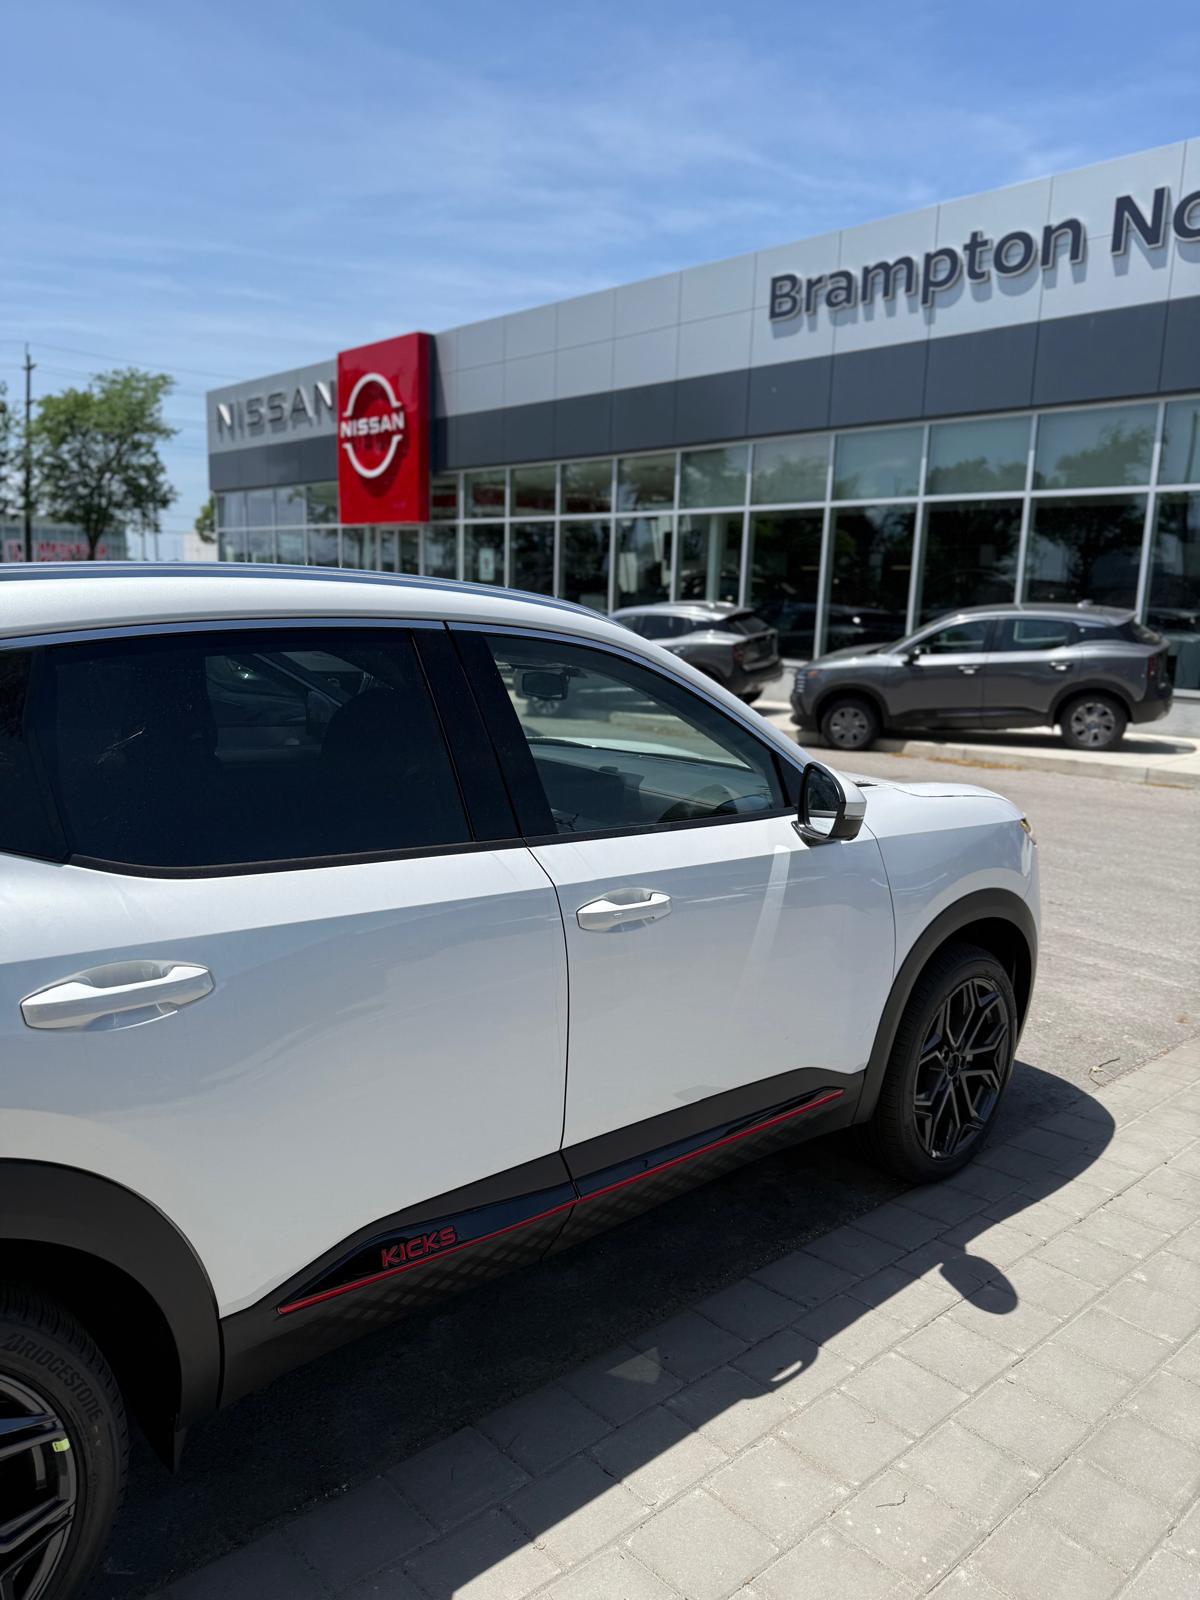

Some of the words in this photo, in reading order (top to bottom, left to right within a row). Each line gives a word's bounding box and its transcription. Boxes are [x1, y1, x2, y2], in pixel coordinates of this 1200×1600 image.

[768, 217, 1087, 322] Brampton
[217, 380, 336, 438] NISSAN
[340, 411, 404, 438] NISSAN
[381, 1226, 456, 1267] KICKS
[2, 1332, 104, 1423] BRIDGESTONE
